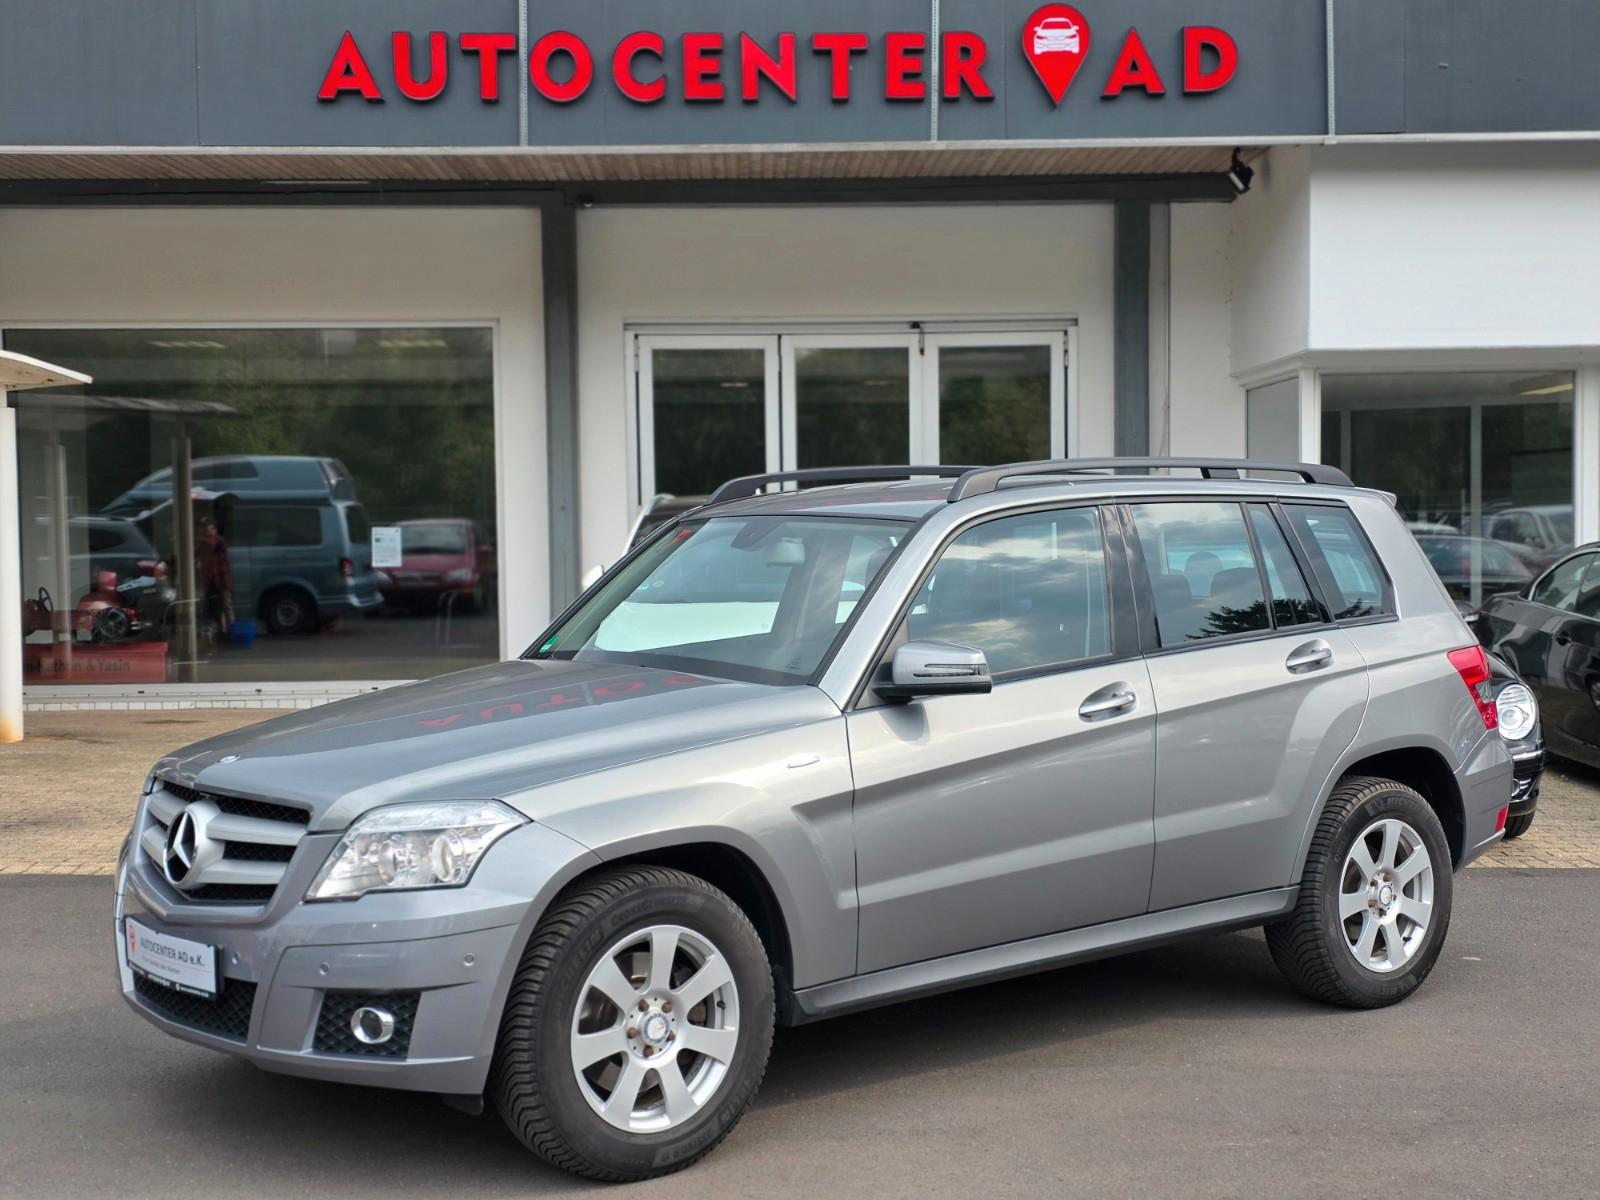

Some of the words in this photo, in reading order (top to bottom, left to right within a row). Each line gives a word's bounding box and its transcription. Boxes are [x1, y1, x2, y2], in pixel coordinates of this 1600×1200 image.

[316, 30, 995, 104] AUTOCENTER
[1101, 26, 1239, 98] AD
[140, 937, 176, 960] AUTOCENTER
[178, 951, 188, 964] AD
